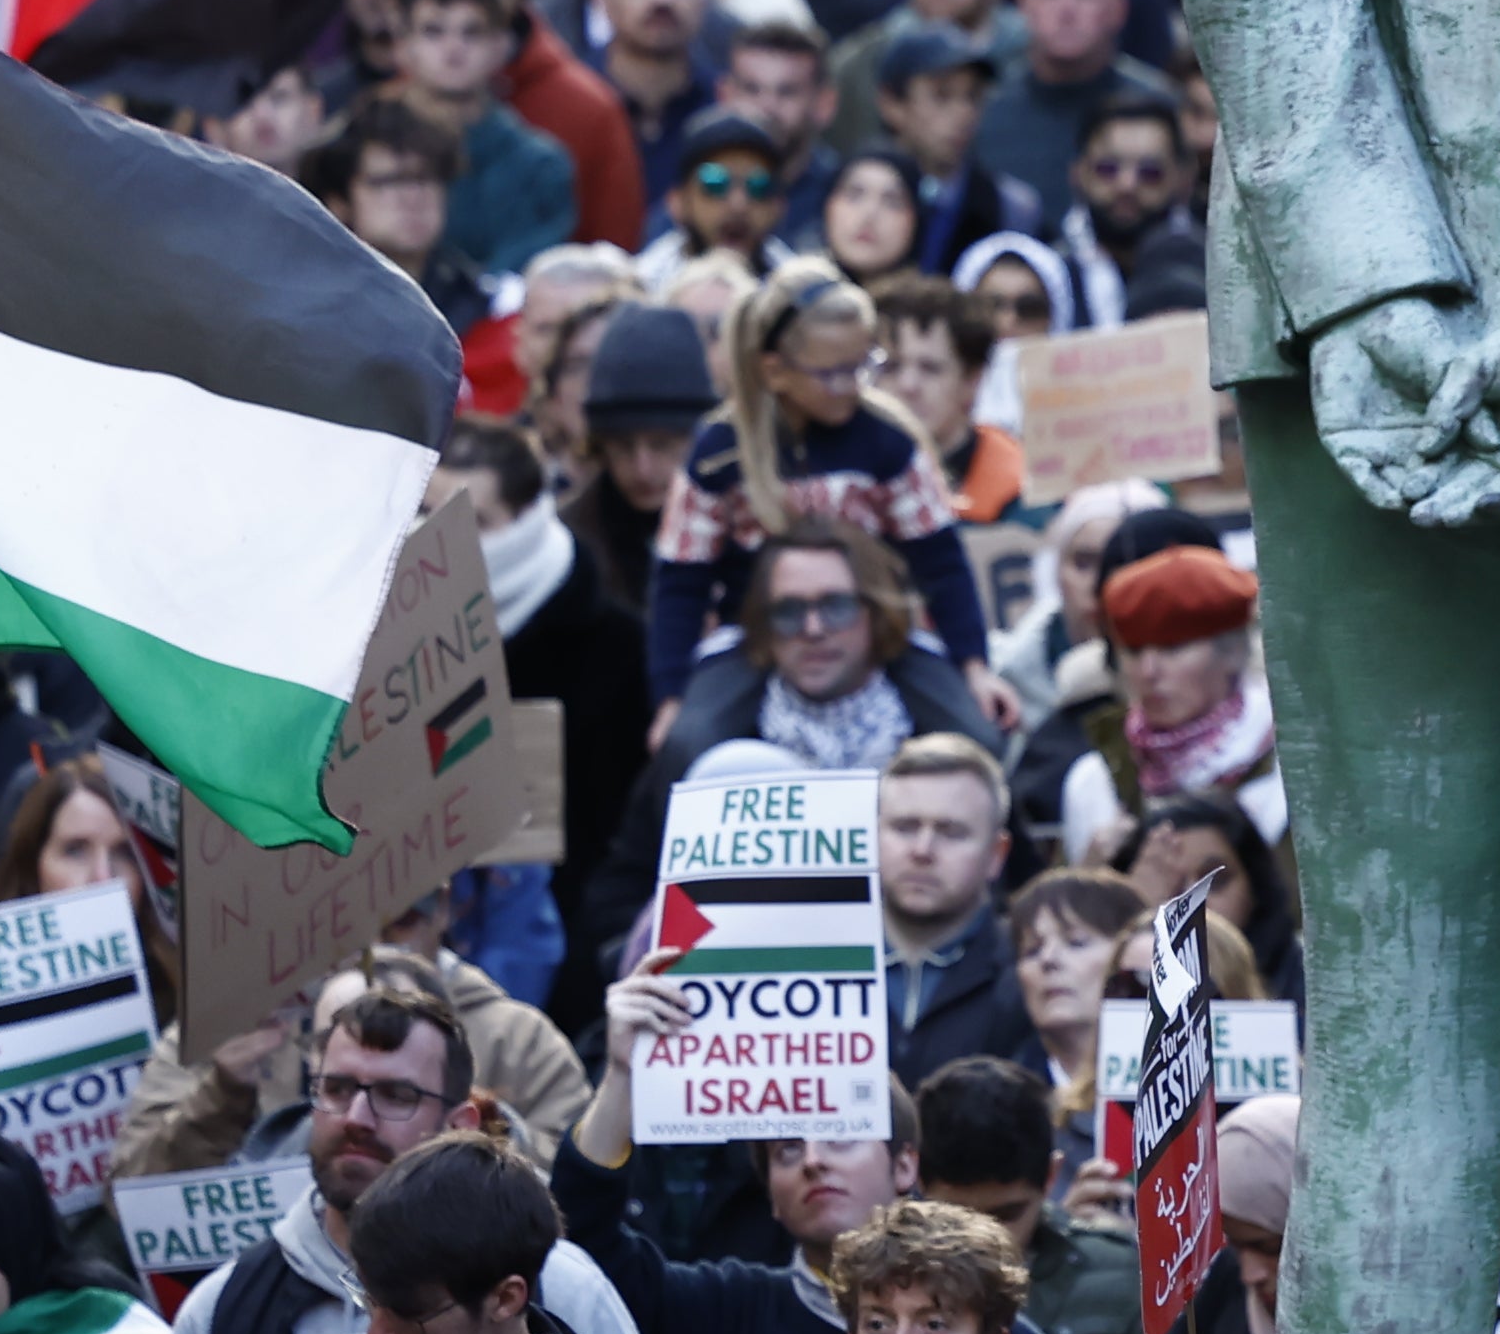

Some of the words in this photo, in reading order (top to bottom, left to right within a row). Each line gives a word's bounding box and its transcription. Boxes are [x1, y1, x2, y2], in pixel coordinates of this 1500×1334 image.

[721, 784, 806, 823] FREE
[667, 827, 869, 873] PALESTINE
[678, 977, 878, 1020] OYCOTT
[646, 1030, 876, 1067] APARTHEID
[1160, 1031, 1179, 1065] for
[682, 1076, 838, 1117] ISRAEL
[1133, 1014, 1211, 1170] PALESTINE
[181, 1176, 277, 1220] FREE
[134, 1211, 285, 1265] PALEST
